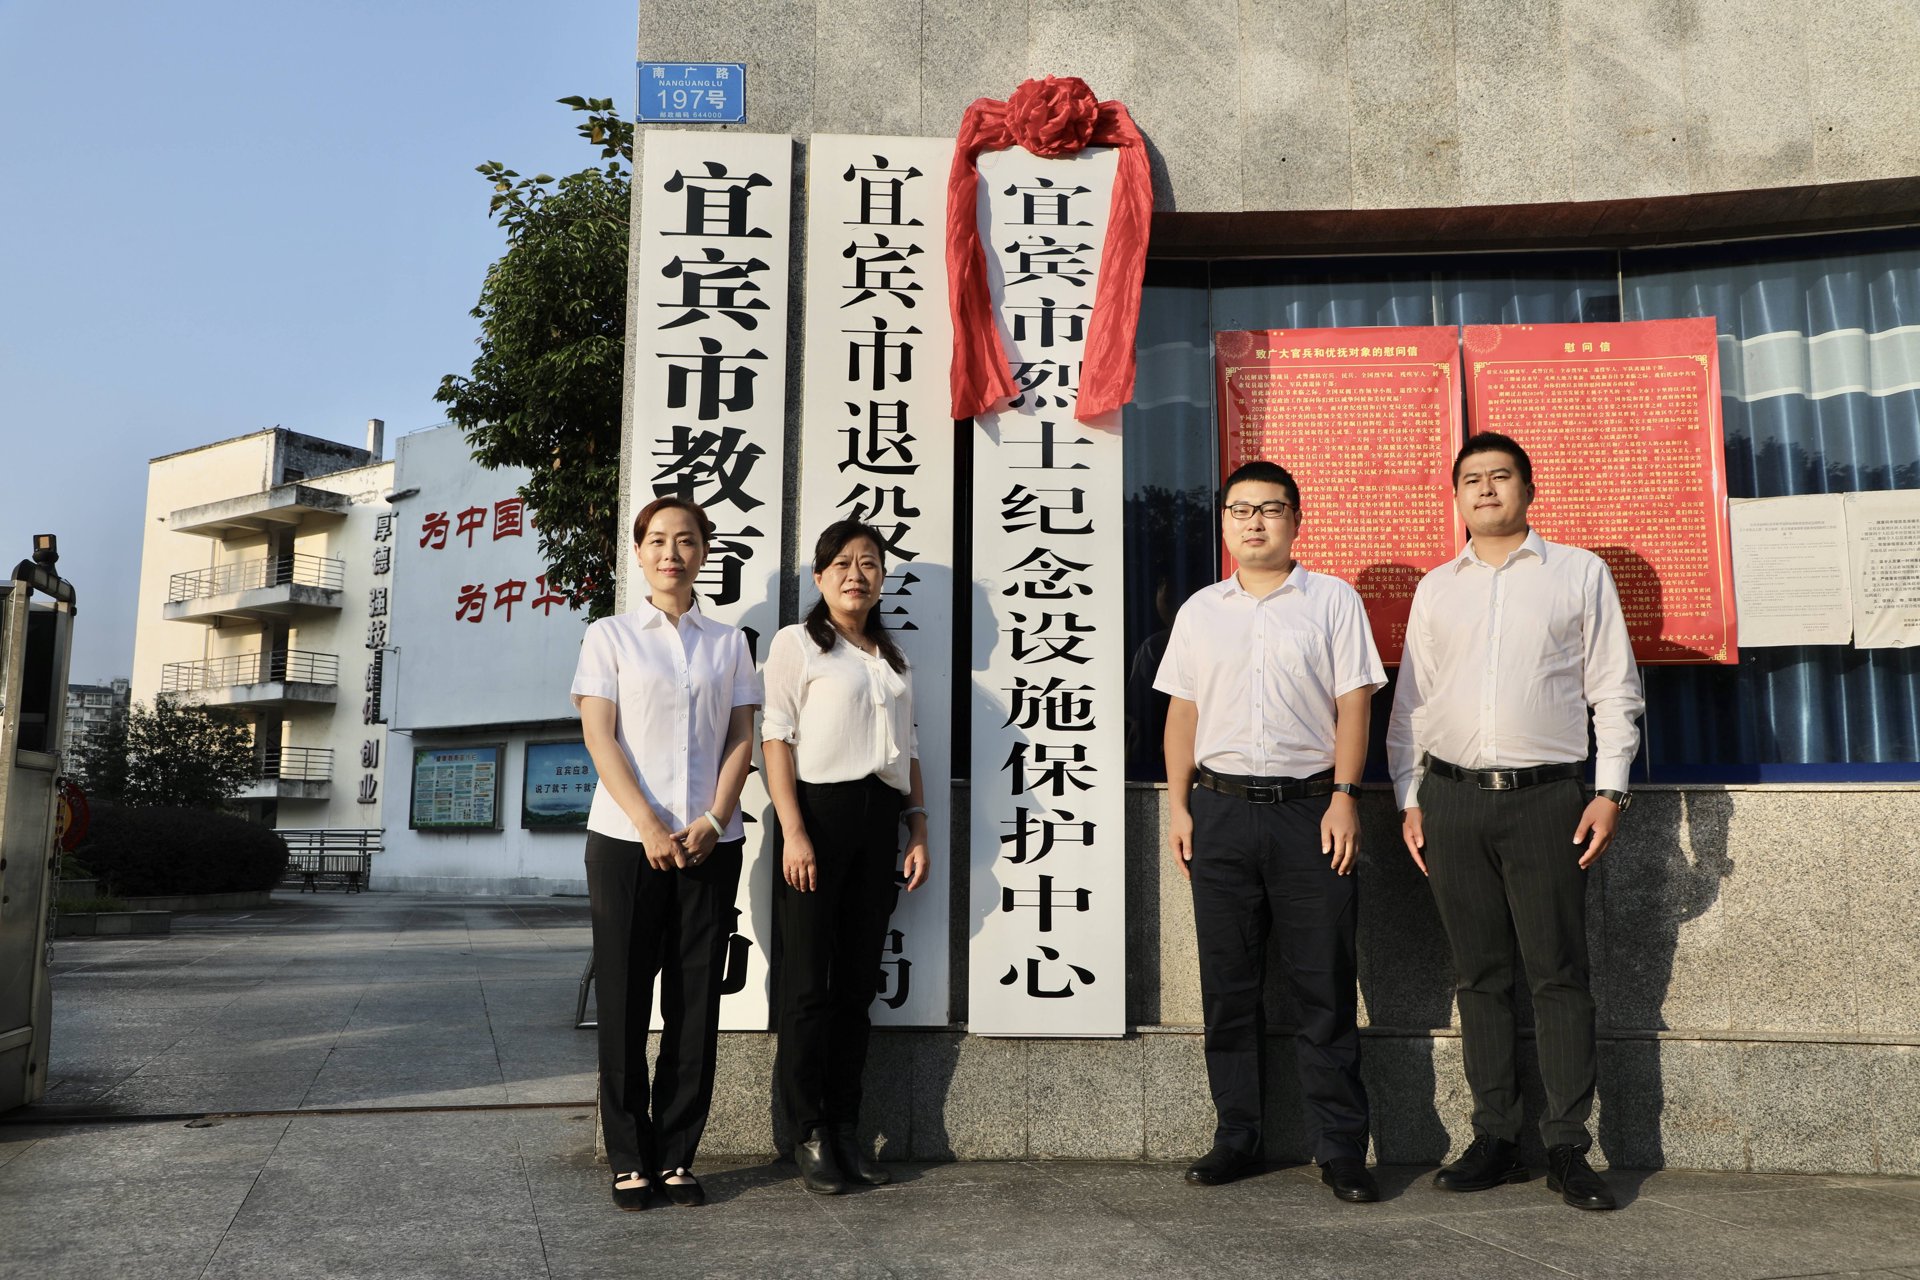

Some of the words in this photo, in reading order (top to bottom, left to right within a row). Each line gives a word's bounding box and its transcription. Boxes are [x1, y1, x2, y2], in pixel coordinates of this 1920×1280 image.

[653, 67, 730, 79] 南广路
[657, 89, 727, 109] 197号
[1255, 345, 1419, 360] 致广大官兵和优抚对象的慰问信
[1564, 341, 1612, 353] 慰问信
[419, 497, 538, 550] 为中国
[372, 513, 393, 575] 厚德
[455, 574, 598, 623] 为中华
[1000, 177, 1098, 999] 宜宾市烈士纪念设施保护中心
[357, 738, 380, 804] 创业
[536, 784, 568, 794] 说了就干
